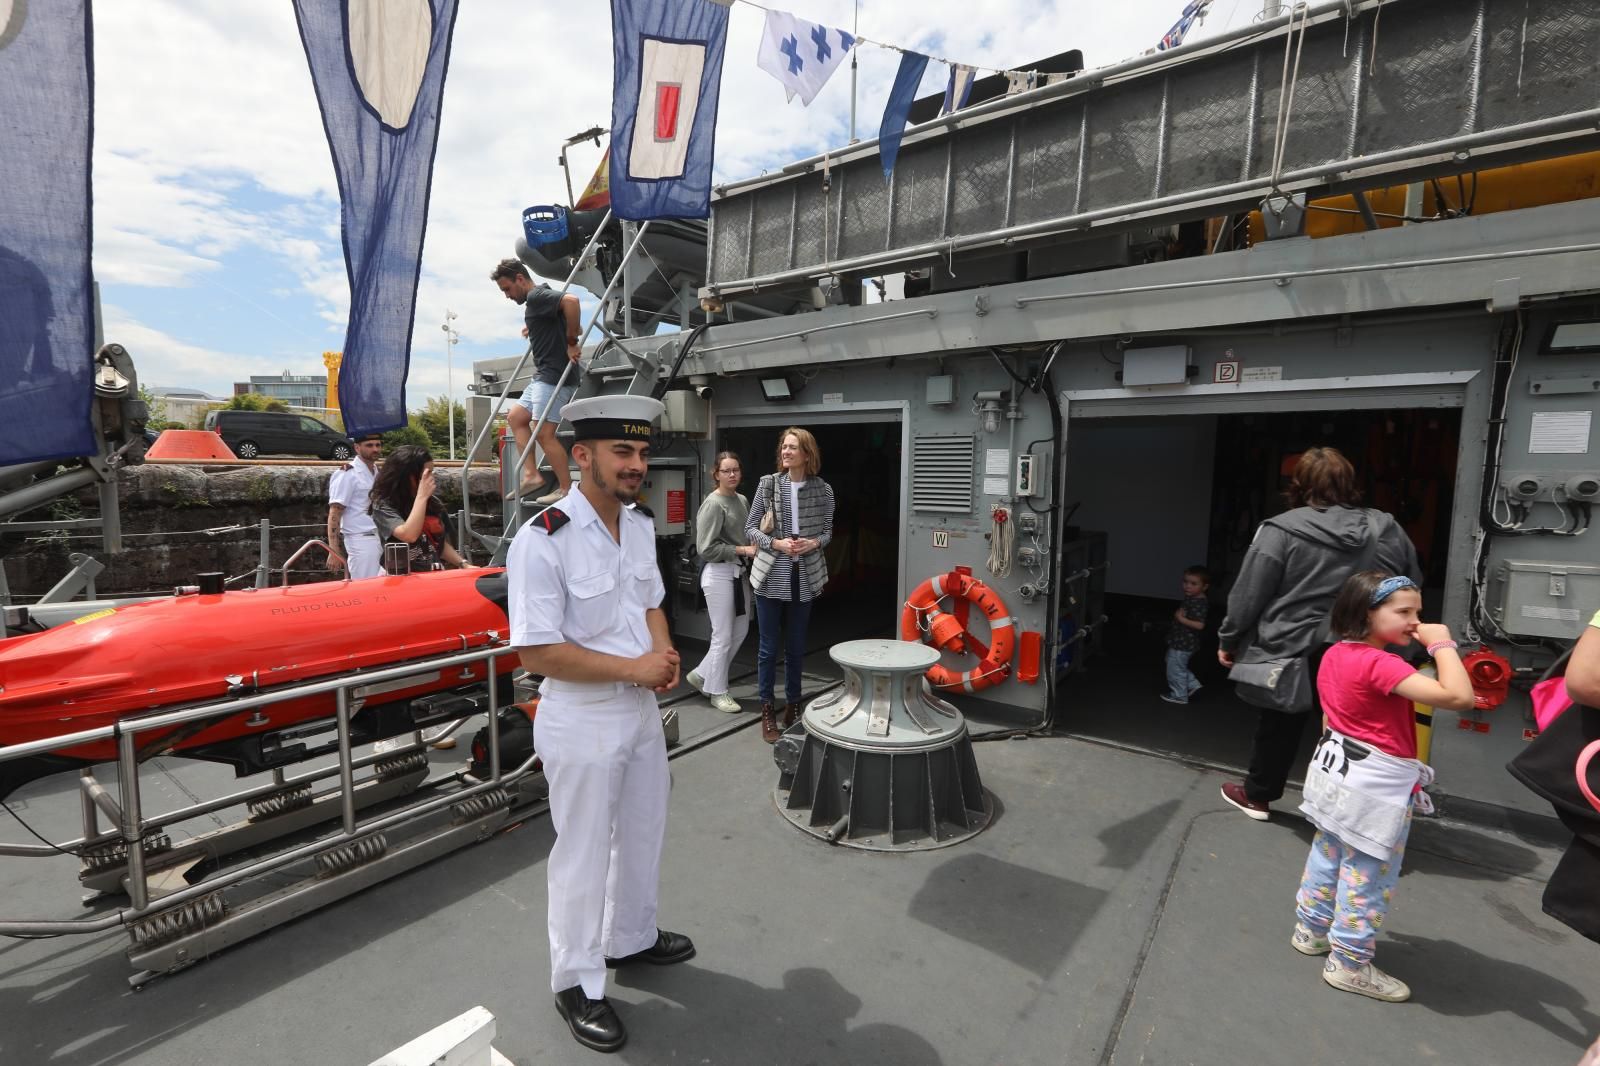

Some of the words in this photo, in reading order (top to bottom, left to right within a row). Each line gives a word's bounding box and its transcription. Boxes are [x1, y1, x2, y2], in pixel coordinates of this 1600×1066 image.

[935, 532, 947, 546] W
[271, 604, 321, 616] PLUTO
[325, 598, 362, 609] PLUS
